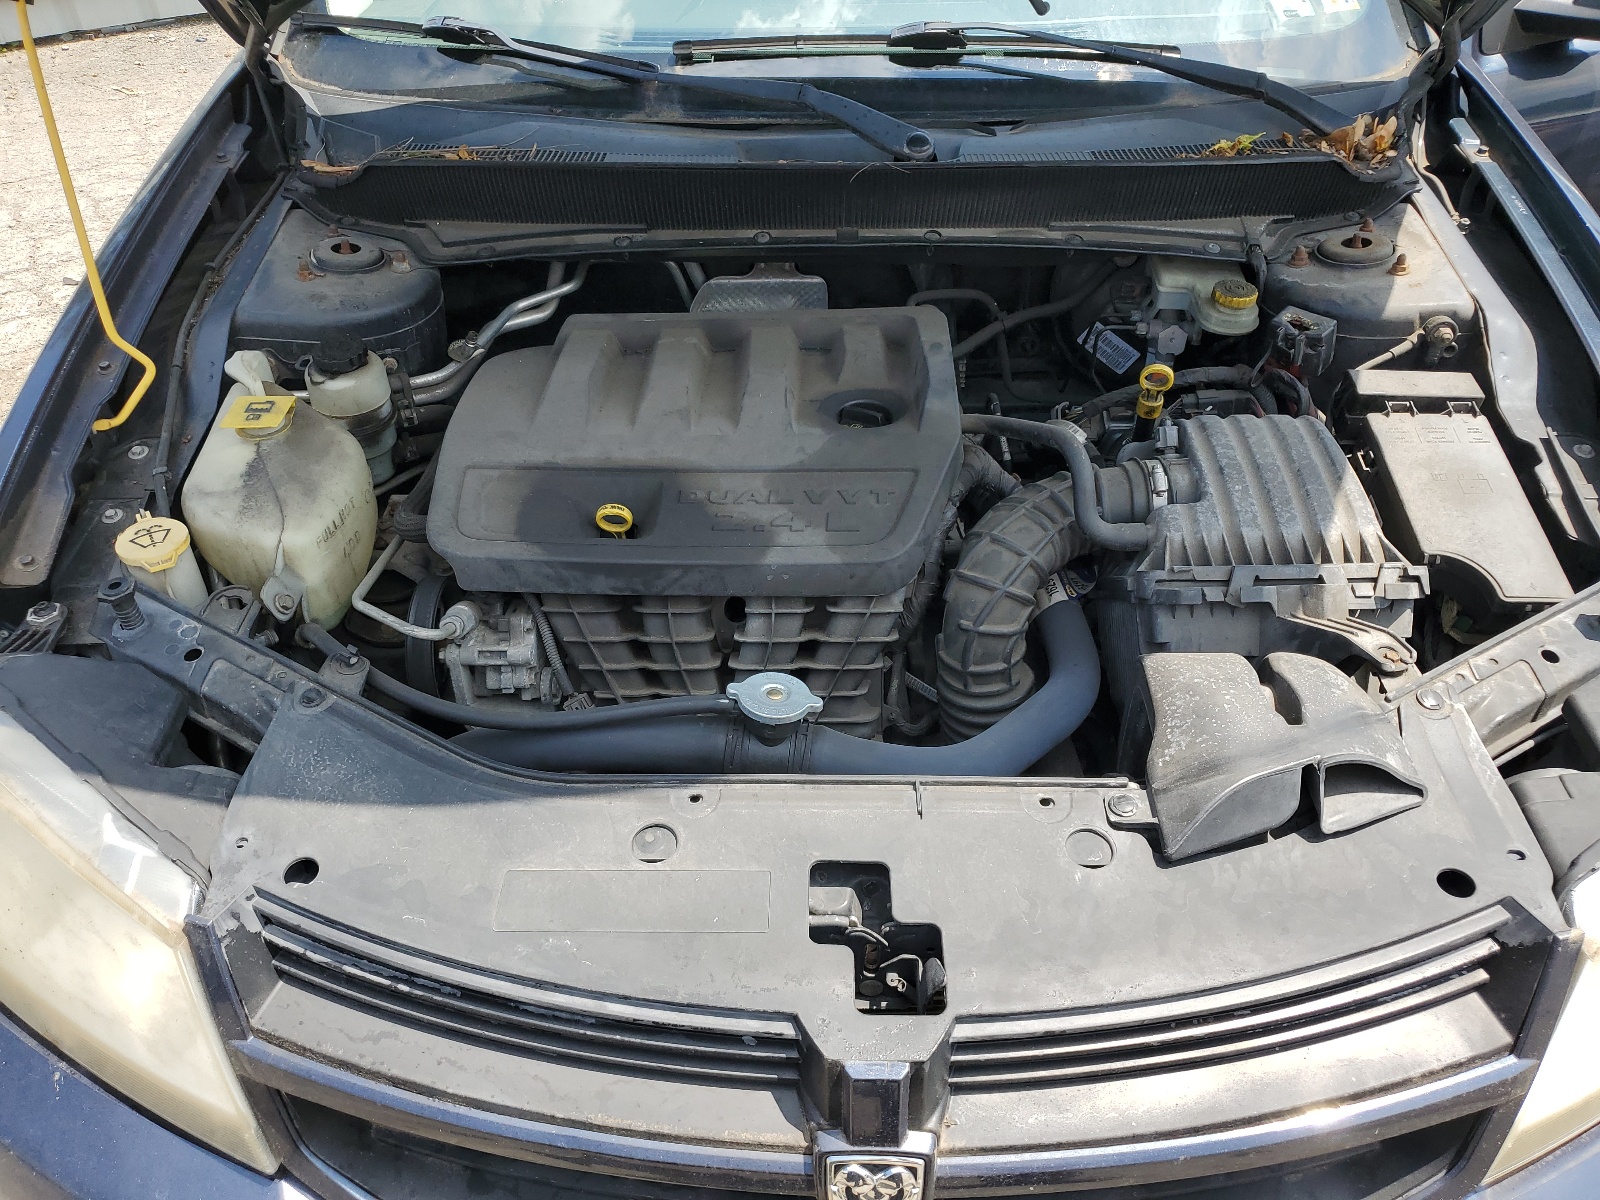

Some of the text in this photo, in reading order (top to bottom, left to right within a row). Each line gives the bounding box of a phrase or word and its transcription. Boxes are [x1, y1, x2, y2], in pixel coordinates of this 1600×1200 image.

[678, 489, 896, 505] DUAL VVT
[711, 510, 860, 533] 2.4L
